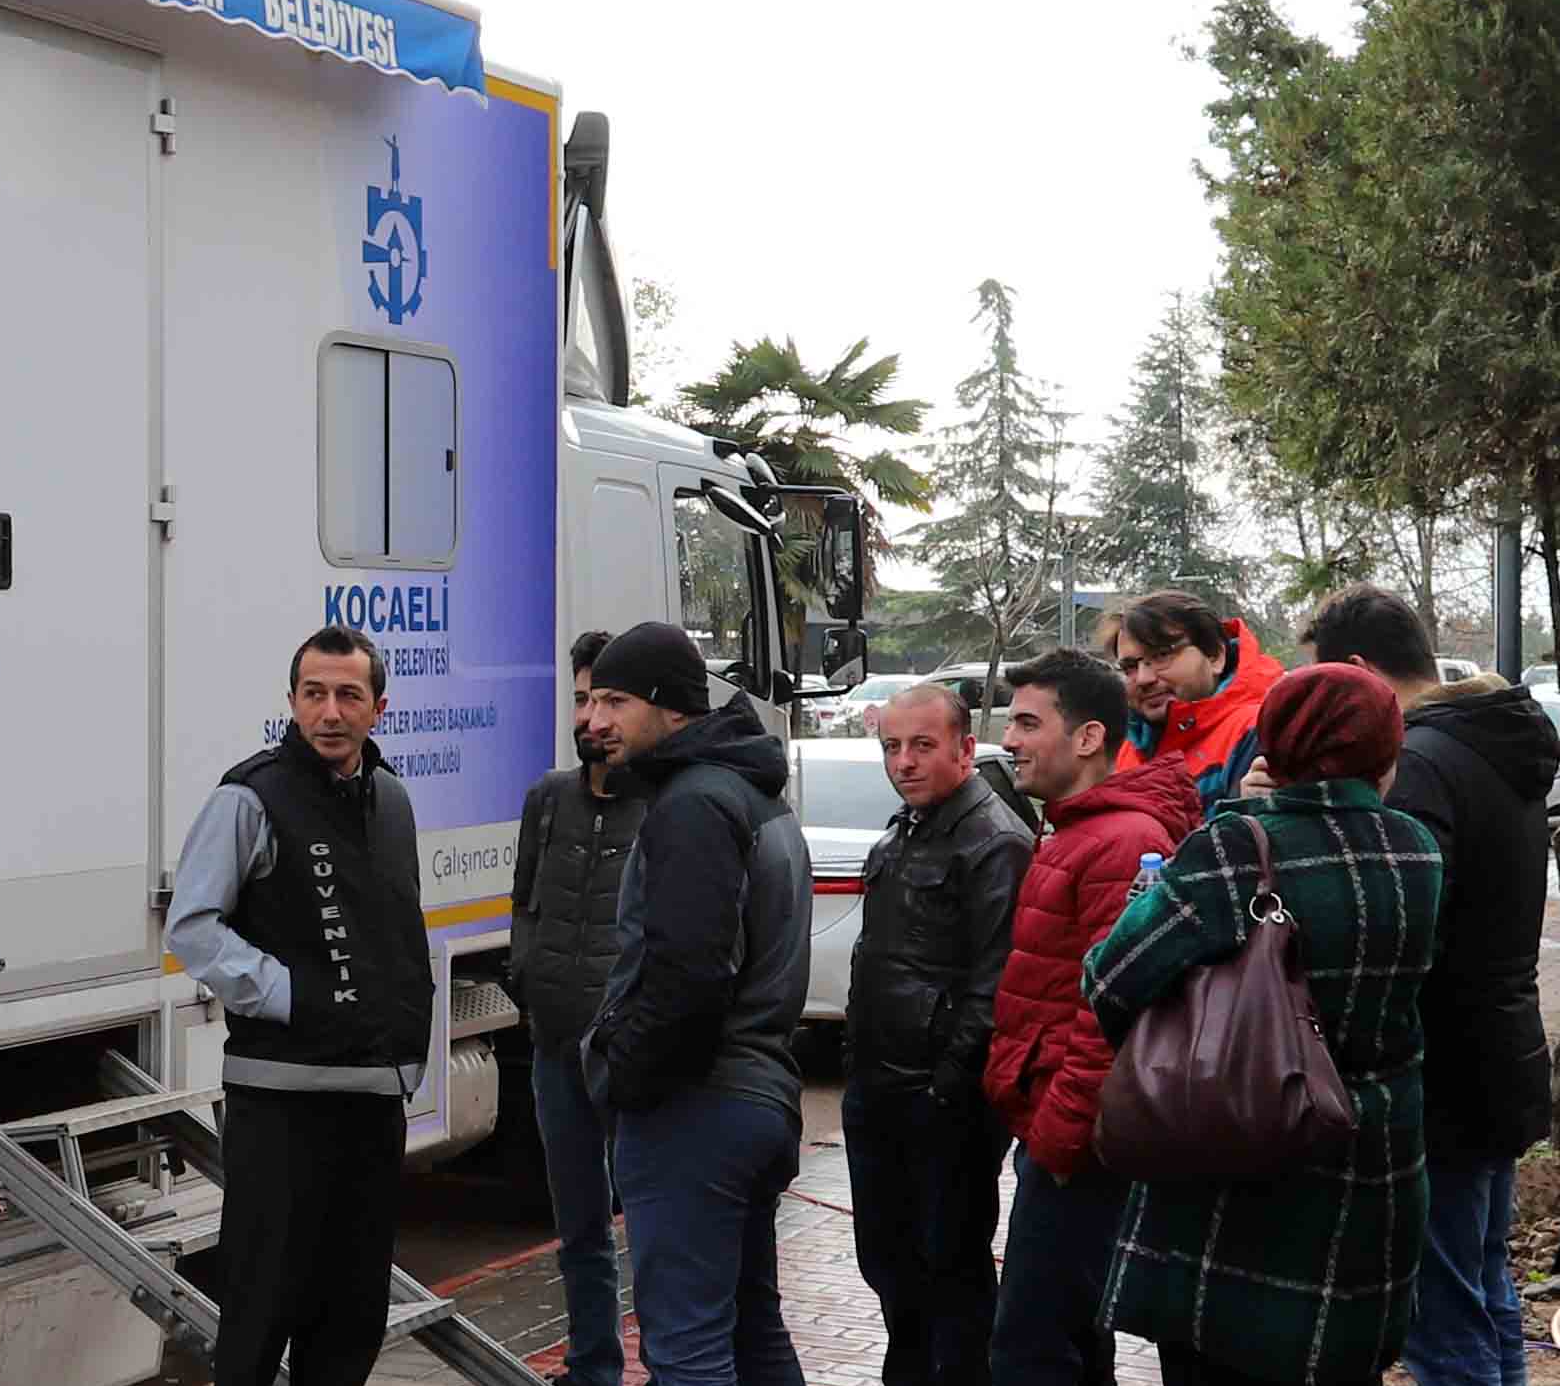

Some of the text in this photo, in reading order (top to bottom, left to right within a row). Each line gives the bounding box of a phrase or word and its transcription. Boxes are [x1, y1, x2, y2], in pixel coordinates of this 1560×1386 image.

[325, 575, 449, 632] KOCAELİ
[432, 845, 498, 886] Çalışınca
[309, 843, 359, 1003] GÜVENLİK
